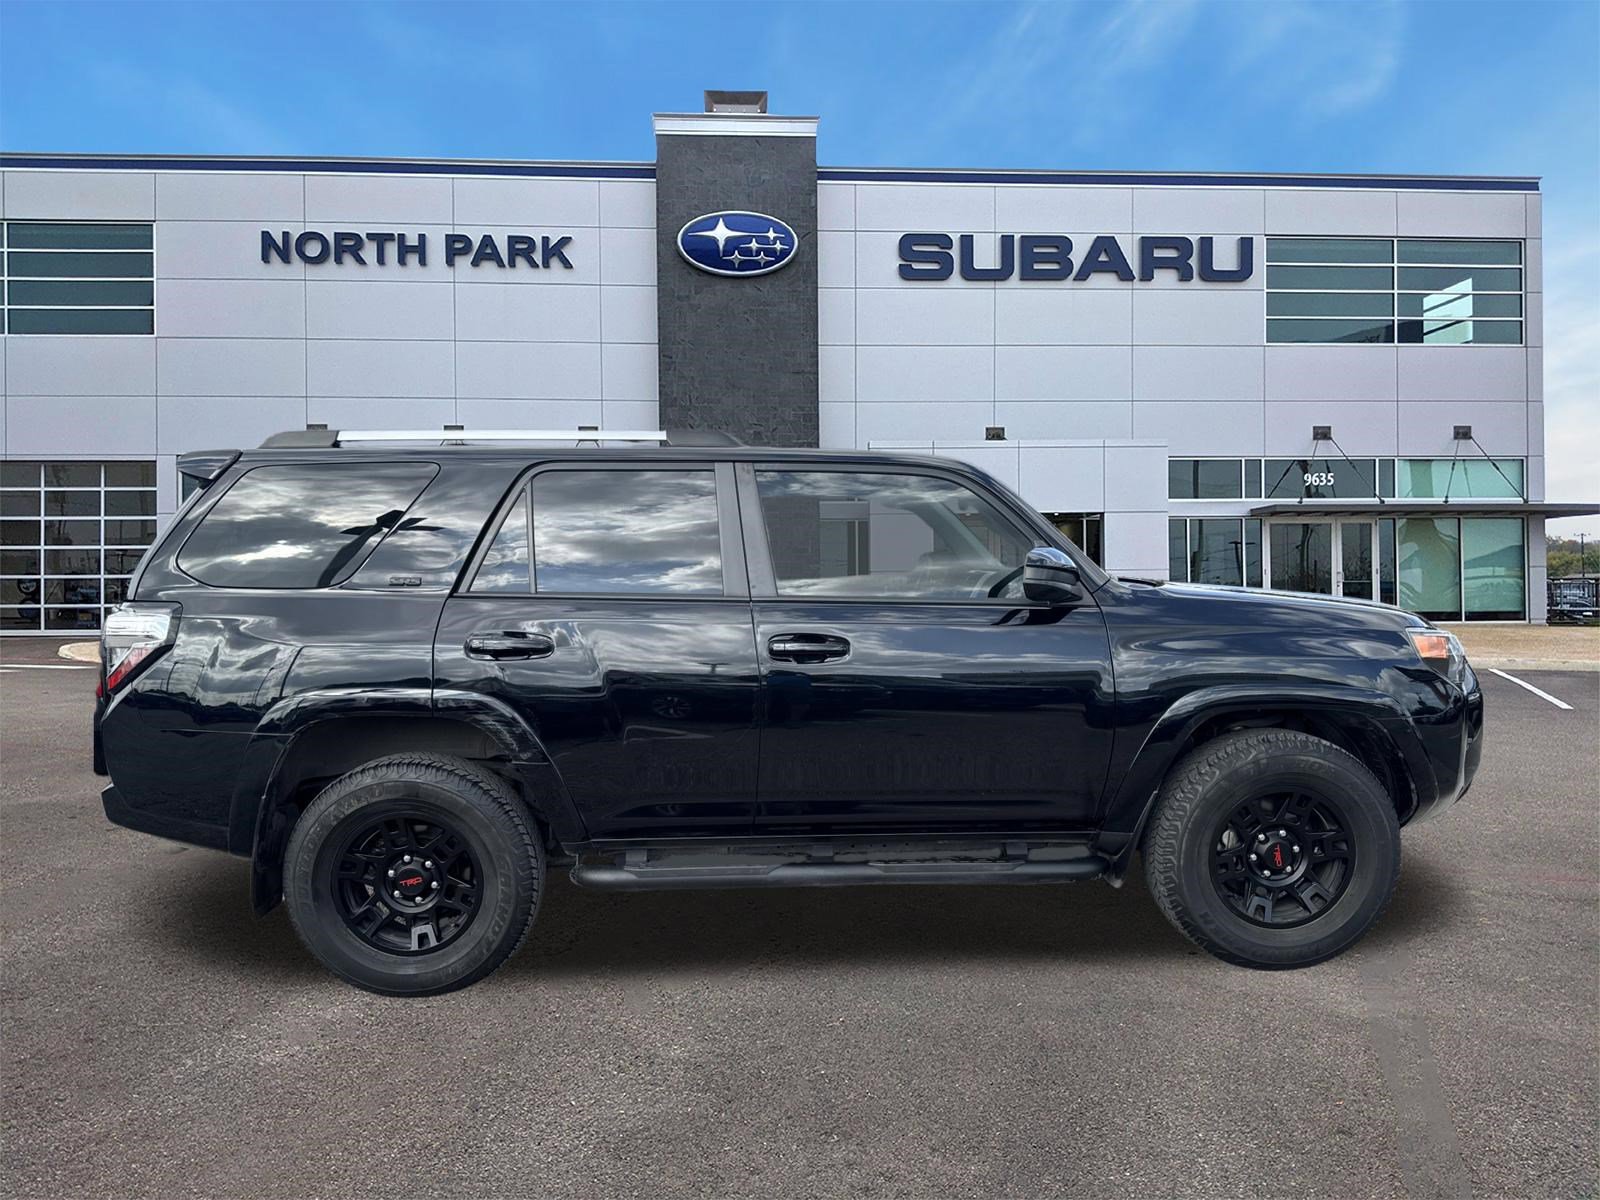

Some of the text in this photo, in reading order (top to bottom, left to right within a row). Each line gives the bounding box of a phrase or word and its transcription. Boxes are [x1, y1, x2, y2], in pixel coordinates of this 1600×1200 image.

[260, 230, 574, 269] NORTH PARK
[898, 233, 1254, 282] SUBARU
[1303, 472, 1335, 486] 9635
[399, 876, 423, 887] TRD
